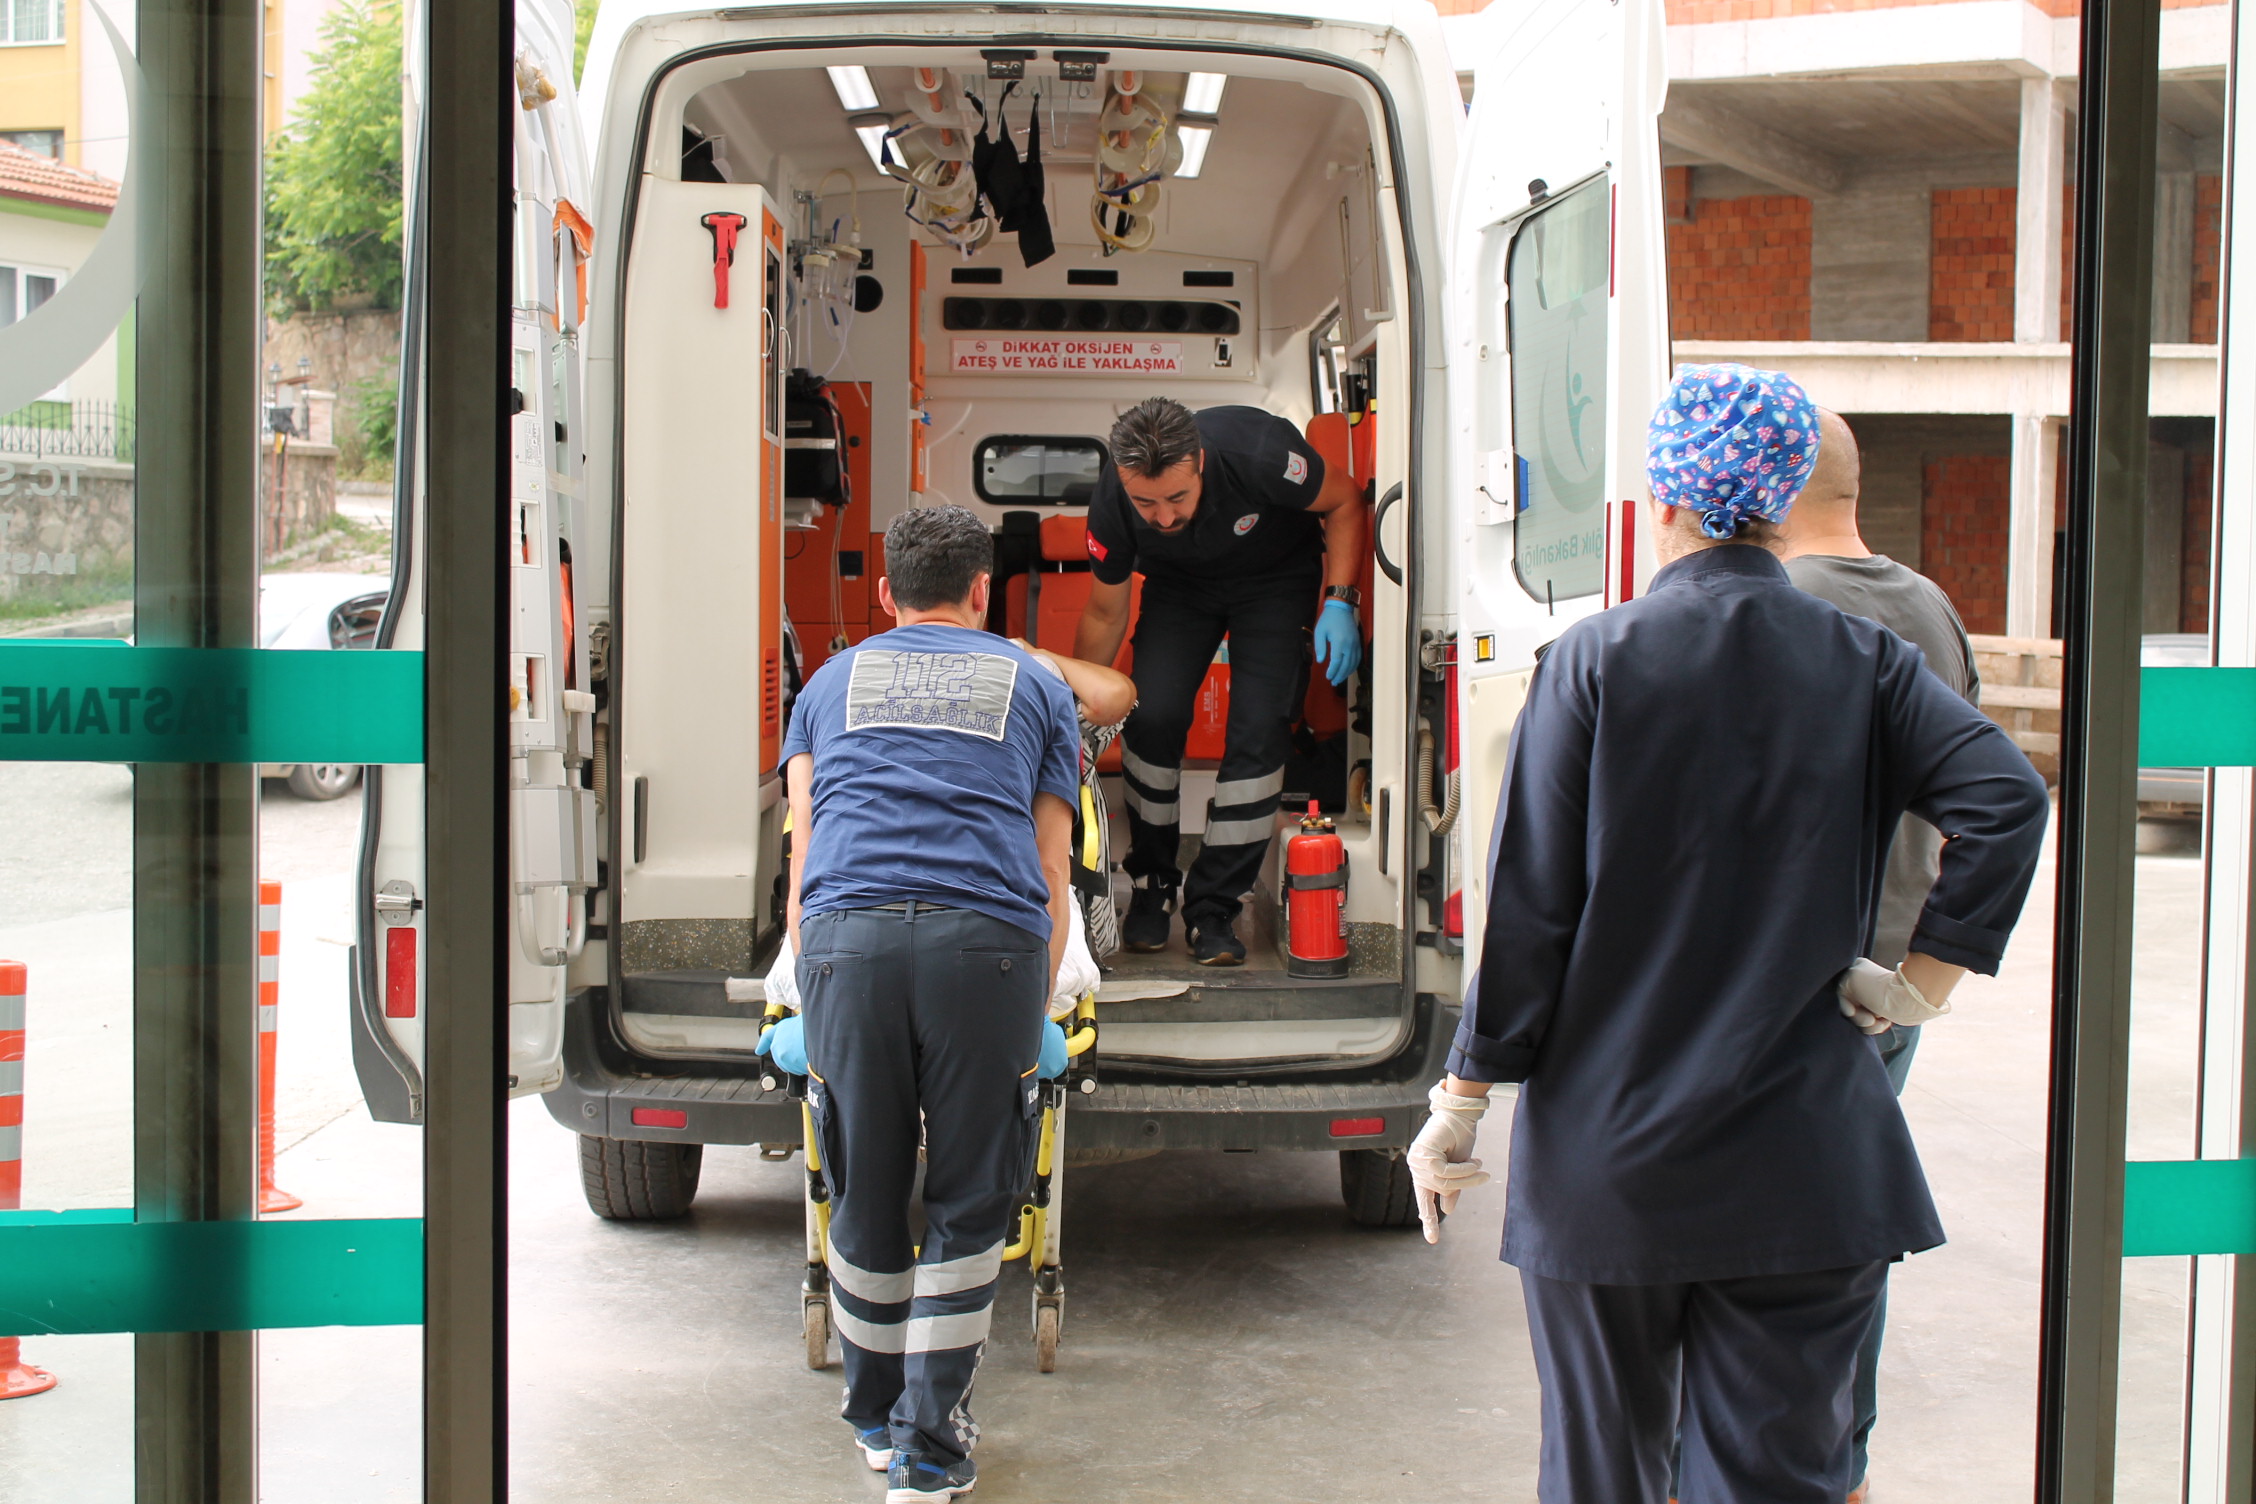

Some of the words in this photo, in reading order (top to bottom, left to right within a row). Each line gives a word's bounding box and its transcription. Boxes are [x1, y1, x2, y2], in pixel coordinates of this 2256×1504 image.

[958, 355, 997, 370] ATEŞ
[1003, 356, 1022, 368] VE
[1028, 355, 1058, 368] YAĞ
[1092, 357, 1176, 372] YAKLAŞMA
[885, 651, 977, 702] 112
